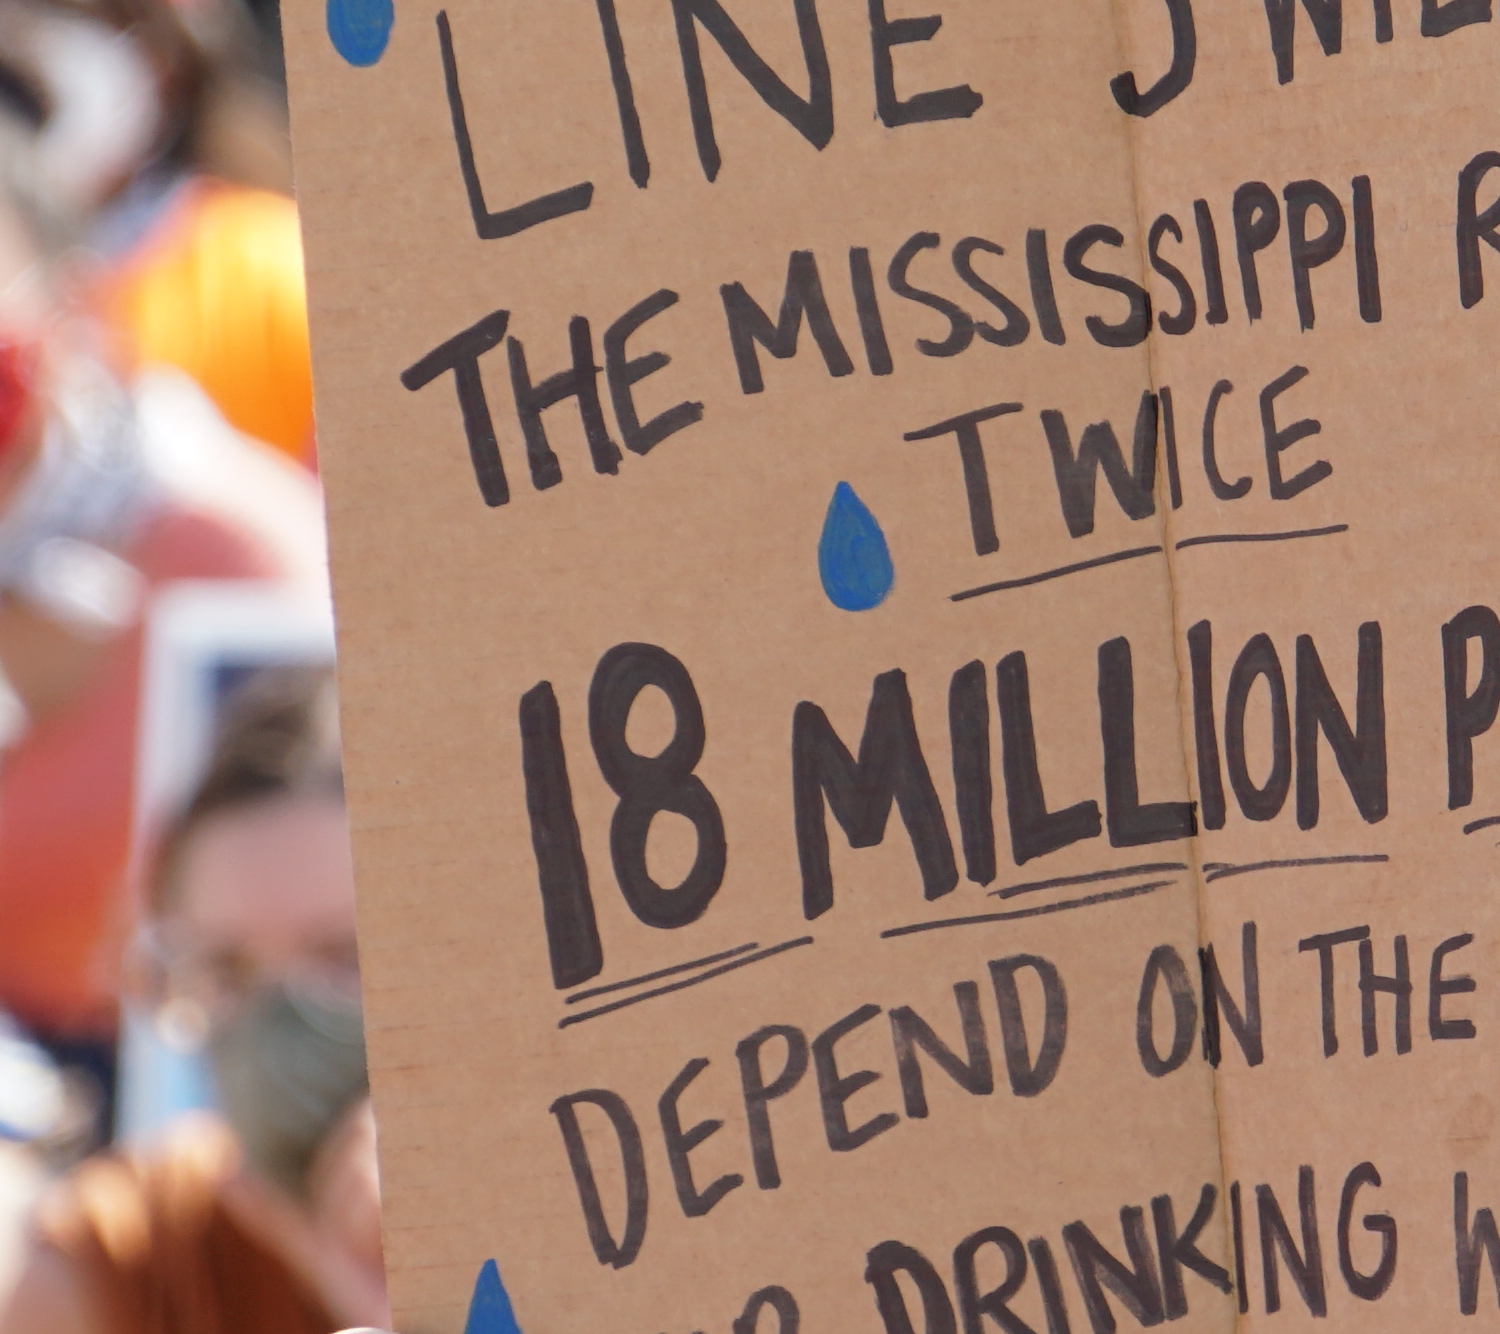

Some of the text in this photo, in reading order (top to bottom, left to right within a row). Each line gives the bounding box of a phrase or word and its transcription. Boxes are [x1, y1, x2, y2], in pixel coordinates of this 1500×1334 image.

[400, 287, 706, 509] THE
[718, 173, 1383, 396] MISSISSIPPI
[902, 364, 1334, 558] TWICE
[517, 640, 729, 992] 18
[790, 619, 1390, 921] MILLION
[547, 952, 1067, 1271] DEPEND
[1135, 919, 1265, 1079] ON
[1297, 923, 1478, 1056] THE
